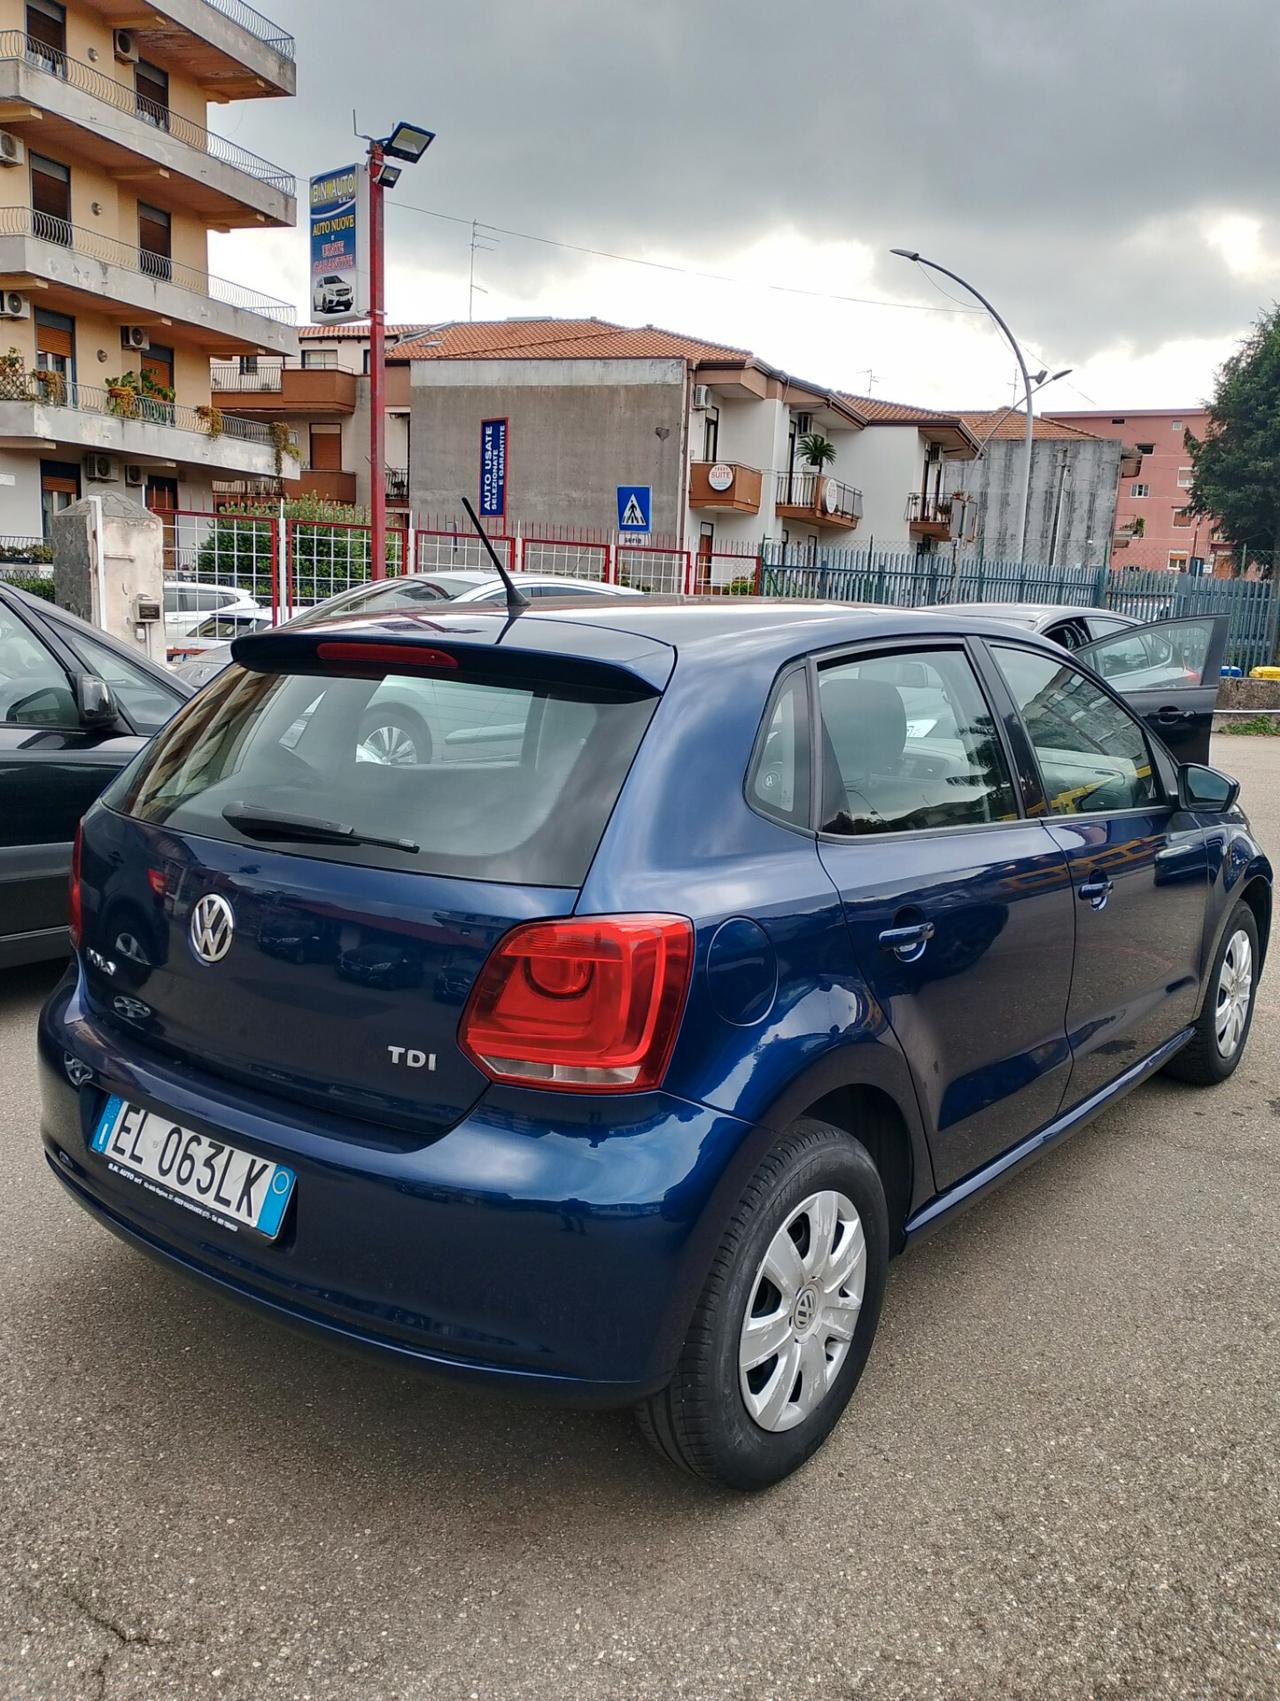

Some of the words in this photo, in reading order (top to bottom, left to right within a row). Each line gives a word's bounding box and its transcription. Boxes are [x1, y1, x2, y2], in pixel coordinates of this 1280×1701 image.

[331, 174, 354, 198] AUTO
[312, 220, 330, 236] AUTO
[331, 215, 354, 232] NUOVE
[485, 426, 493, 470] USATE
[491, 449, 499, 510] SELEZIONATE
[711, 471, 731, 479] SUITE
[484, 474, 492, 511] AUTO
[387, 1045, 437, 1071] TDI
[111, 1103, 149, 1165] EL
